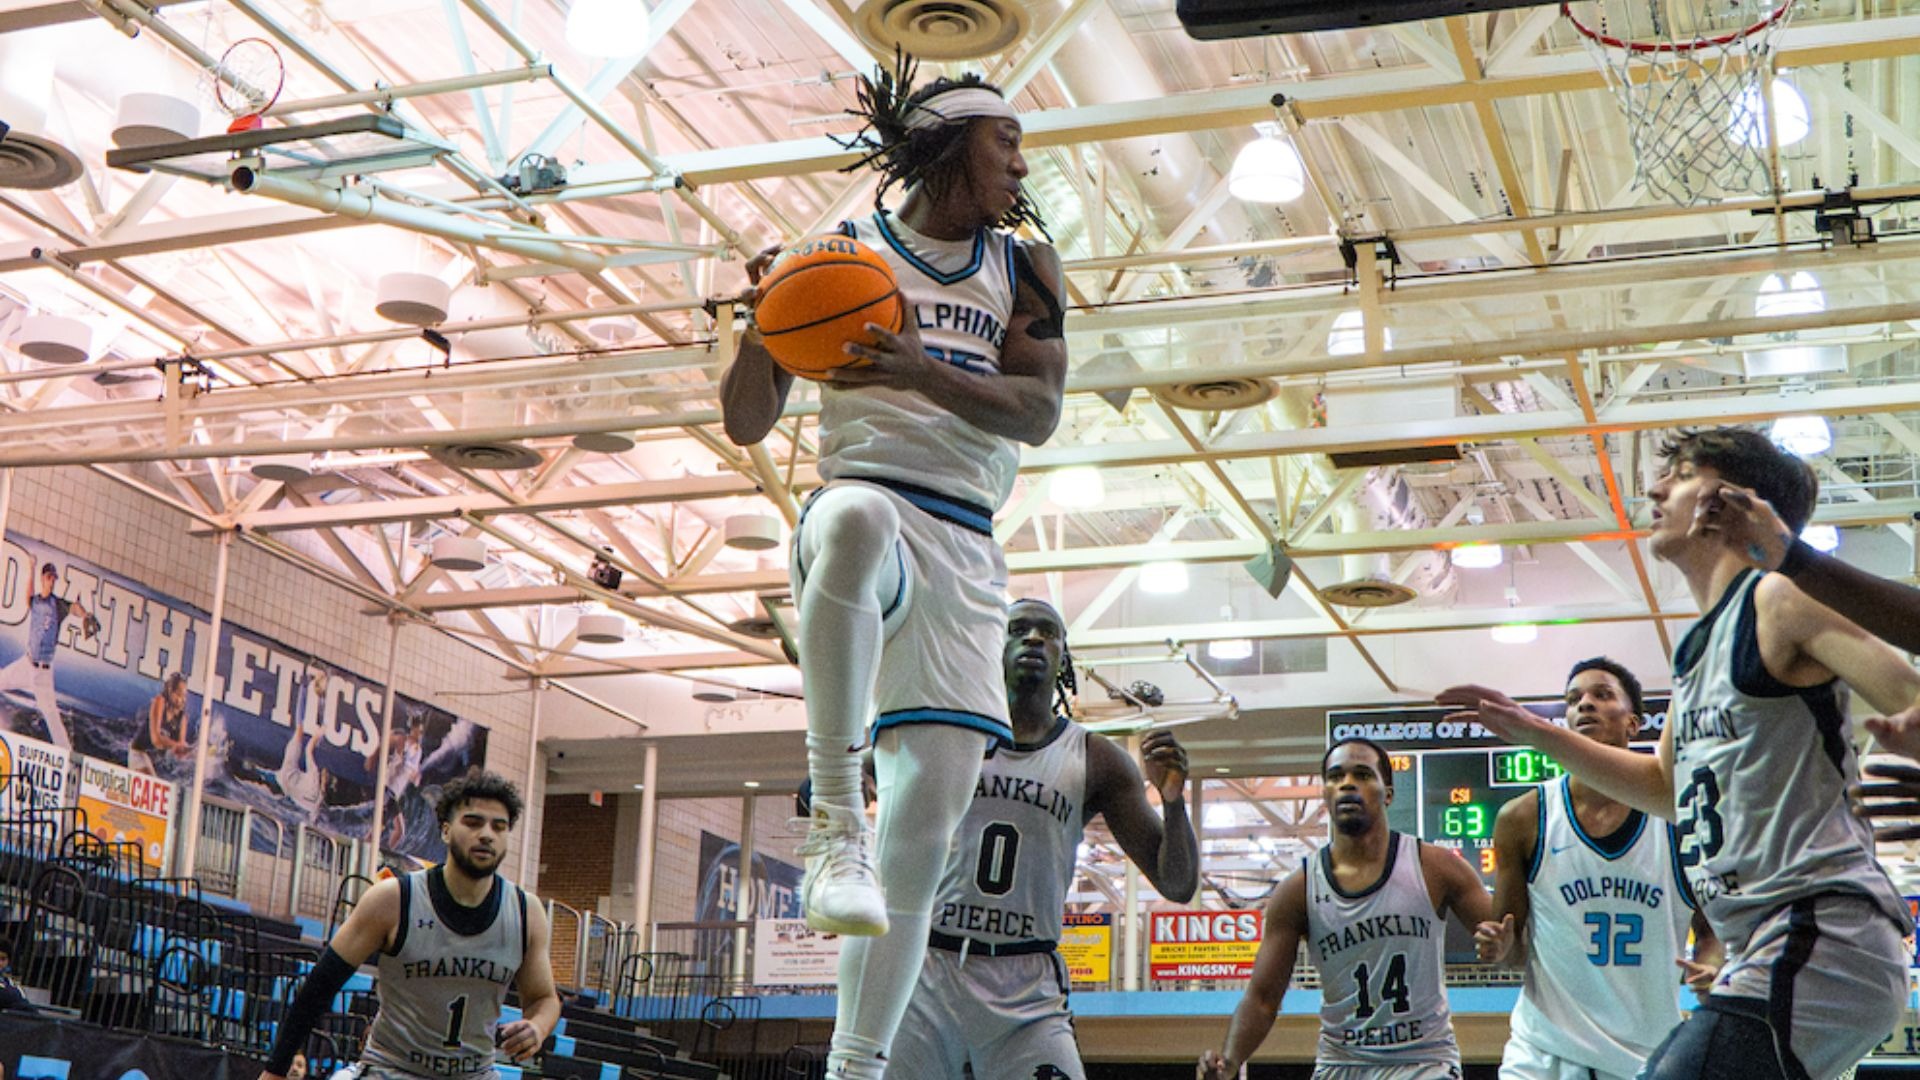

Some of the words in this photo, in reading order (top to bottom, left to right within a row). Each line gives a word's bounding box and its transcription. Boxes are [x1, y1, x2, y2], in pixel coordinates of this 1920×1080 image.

[915, 303, 1006, 349] LPHINS
[57, 564, 383, 757] ATHLETICS
[1333, 722, 1433, 741] COLLEGE
[1436, 722, 1467, 739] OF
[18, 744, 64, 768] BUFFALO
[18, 760, 62, 791] WILD
[84, 763, 131, 795] tropical
[131, 776, 171, 815] CAFE
[15, 783, 59, 810] WINGS
[973, 774, 1073, 824] ANKLIN
[1451, 787, 1470, 803] CSI
[1445, 806, 1483, 836] 63
[974, 820, 1022, 898] 0
[1559, 876, 1664, 909] DOLPHINS
[940, 903, 1035, 939] PIERCE
[1155, 914, 1258, 942] KINGS
[1318, 914, 1432, 962] FRANKLIN
[1583, 911, 1644, 967] 32
[1352, 952, 1413, 1020] 14
[443, 994, 469, 1048] 1
[1342, 1020, 1425, 1047] PIERCE
